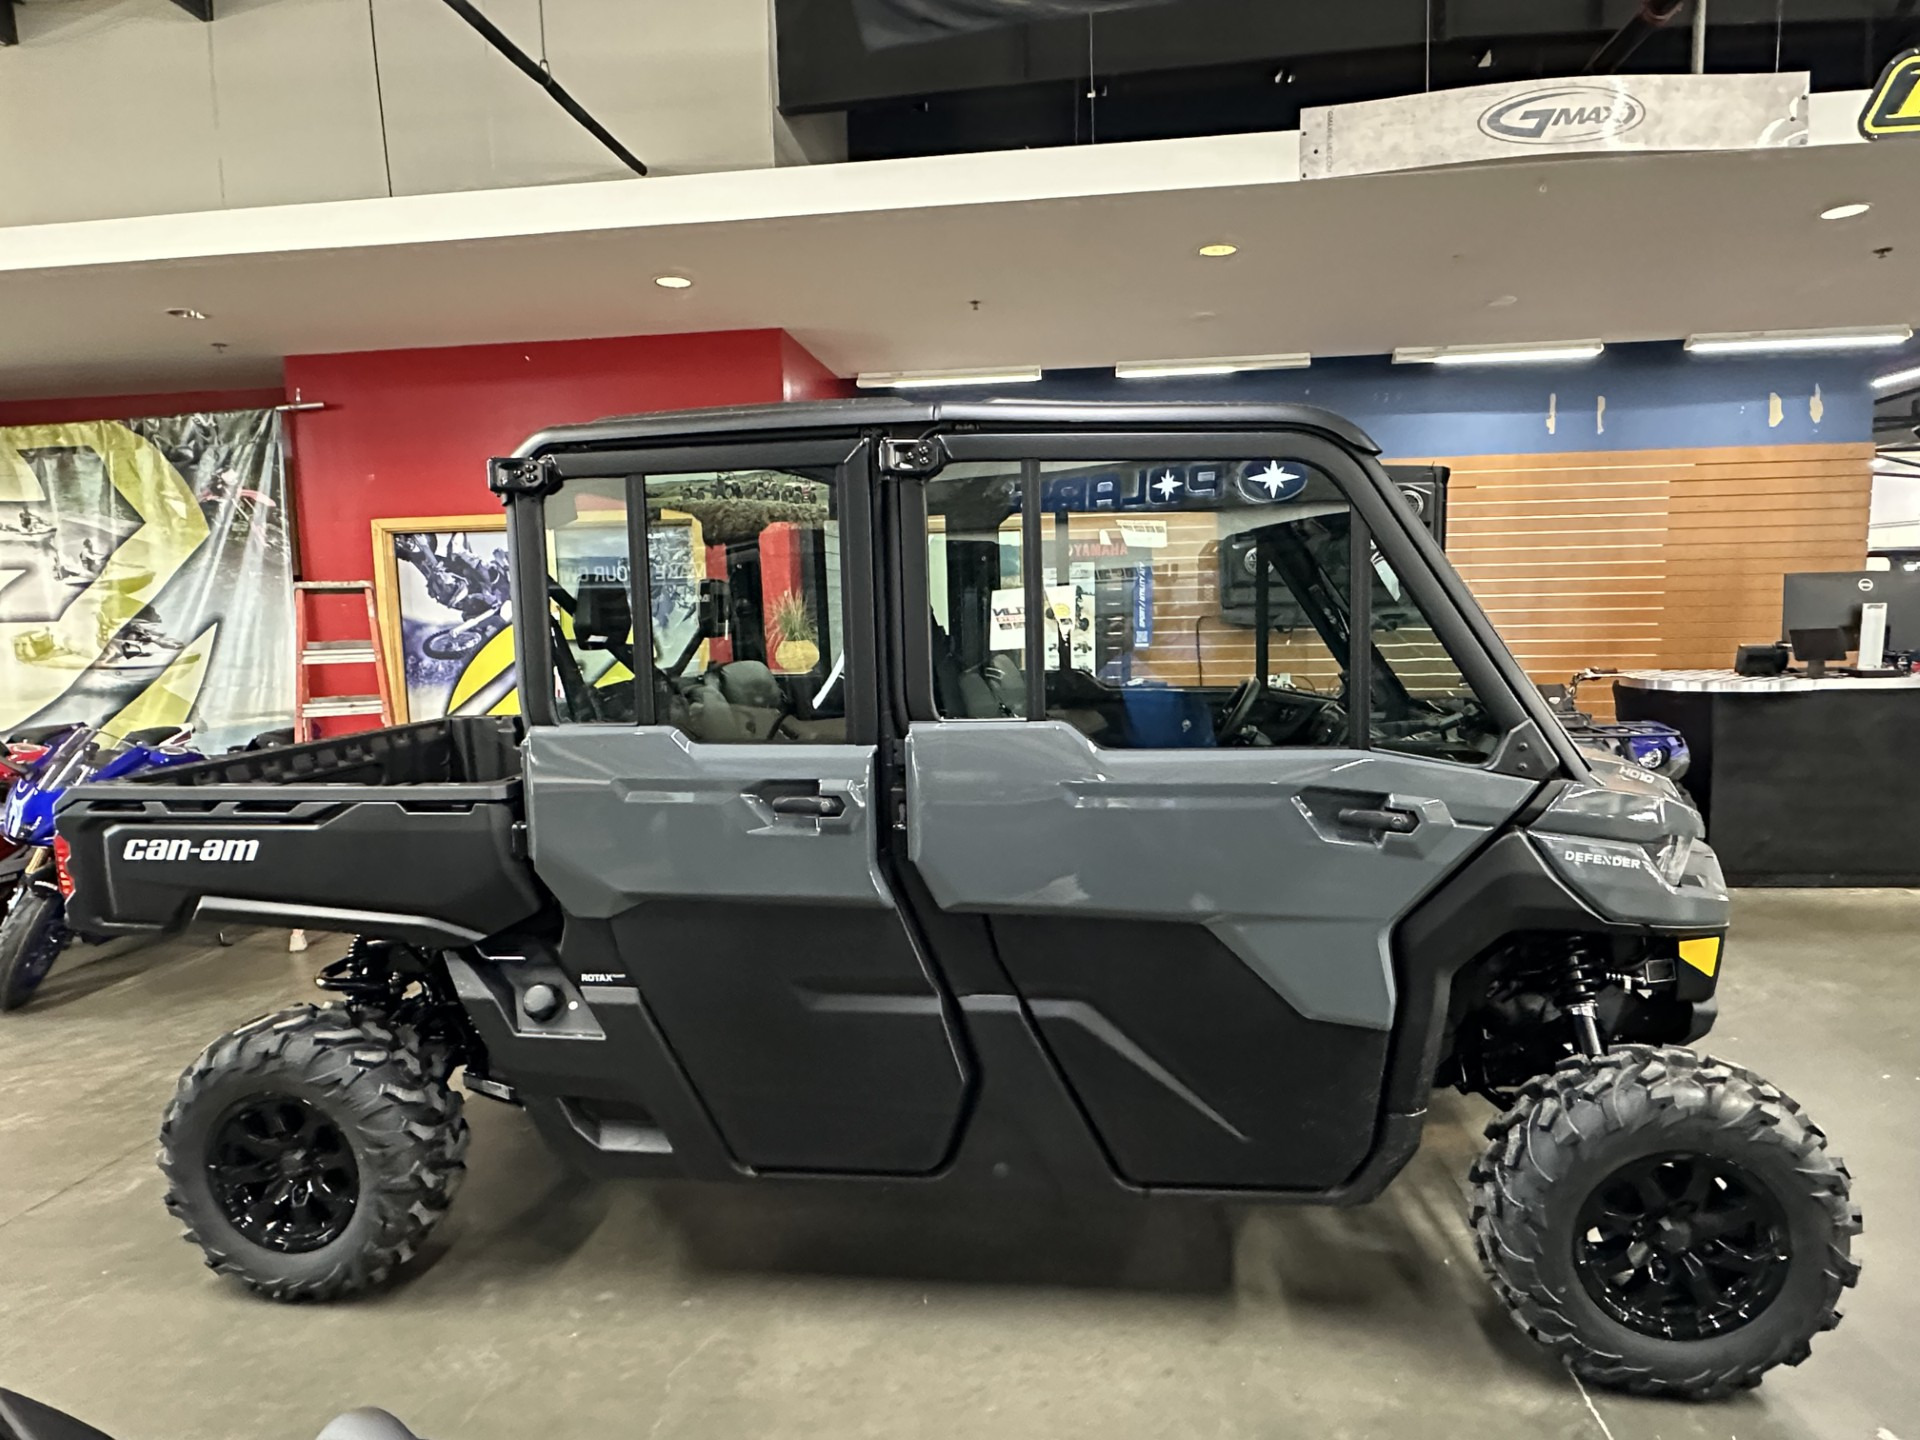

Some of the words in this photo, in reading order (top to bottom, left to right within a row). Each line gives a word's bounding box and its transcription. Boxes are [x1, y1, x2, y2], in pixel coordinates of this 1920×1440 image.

[1073, 543, 1129, 556] YAMAHA
[1619, 765, 1655, 784] HD10
[122, 839, 260, 862] can-am
[1564, 850, 1641, 869] DEFENDER
[581, 973, 613, 982] ROTAX
